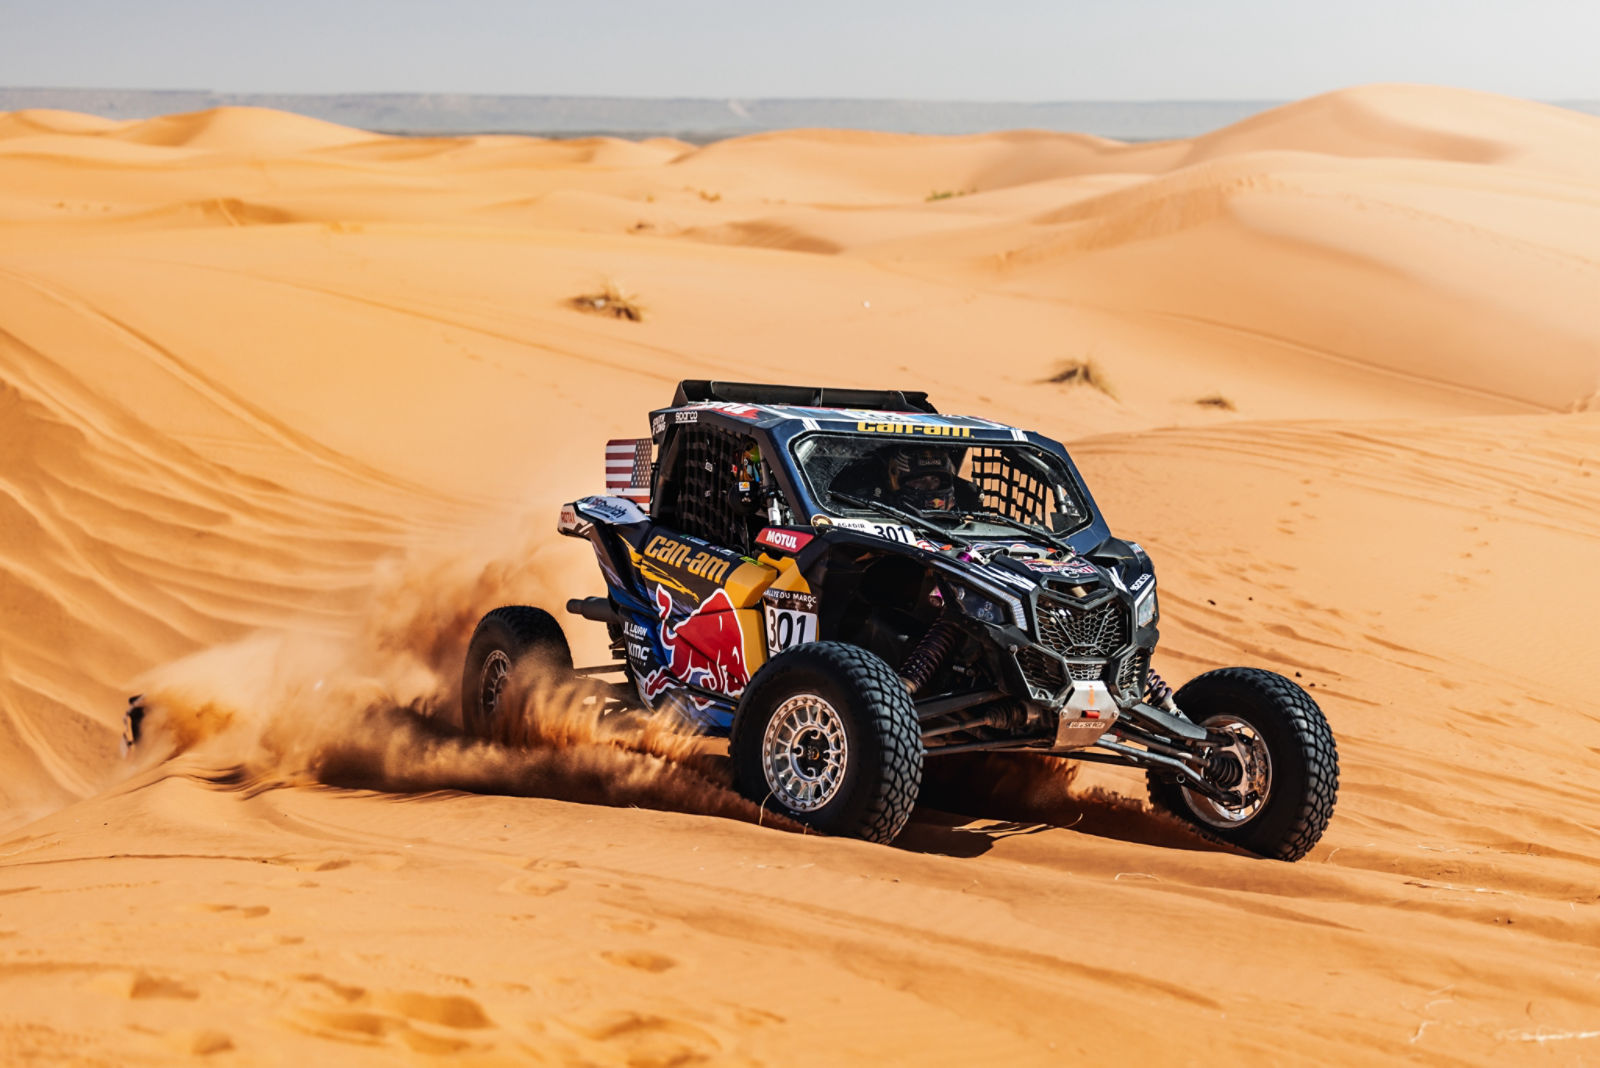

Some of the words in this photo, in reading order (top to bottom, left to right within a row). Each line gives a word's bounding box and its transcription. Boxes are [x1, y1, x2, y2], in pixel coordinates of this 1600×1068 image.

[675, 411, 698, 422] sparco
[766, 530, 797, 549] MOTUL
[874, 525, 909, 543] 301
[644, 535, 731, 584] can-am
[793, 593, 817, 604] MAROC
[769, 609, 807, 650] 301
